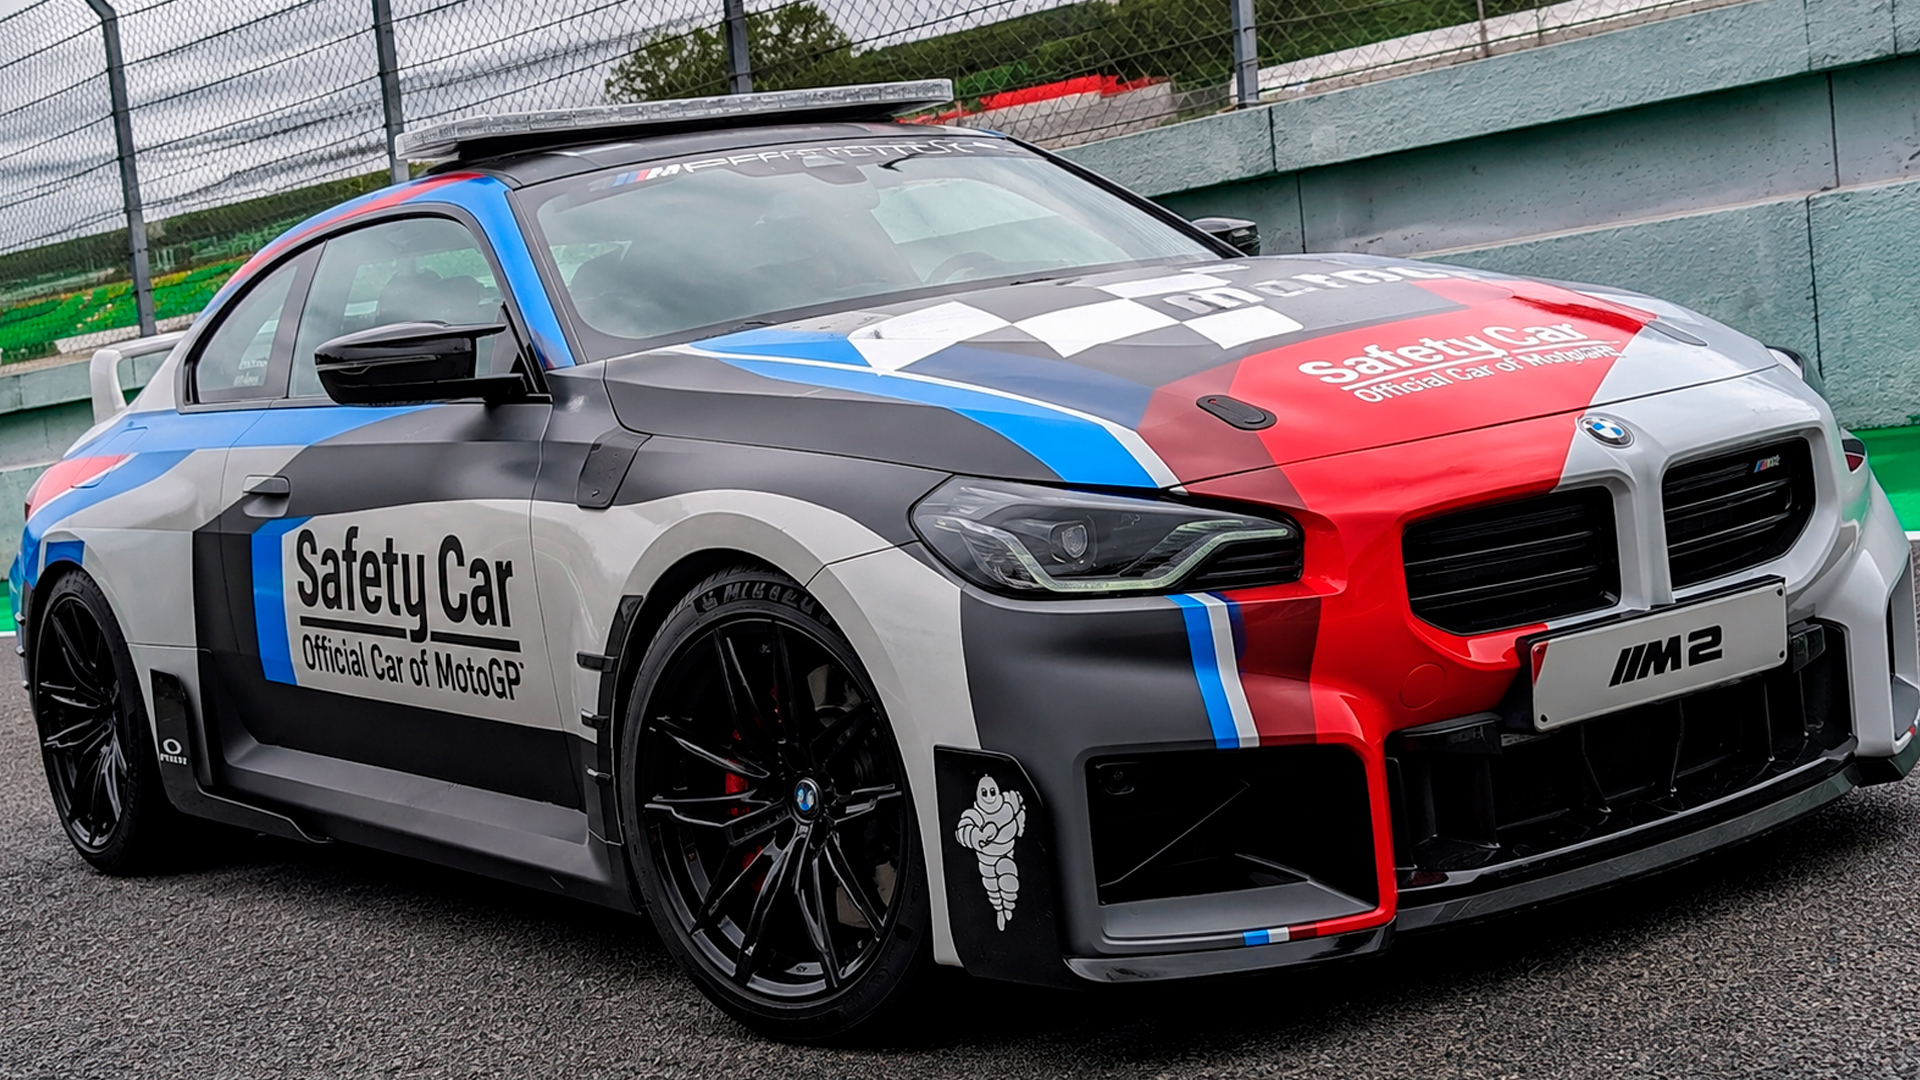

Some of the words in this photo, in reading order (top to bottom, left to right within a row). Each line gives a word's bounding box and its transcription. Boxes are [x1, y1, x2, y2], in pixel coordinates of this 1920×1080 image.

[1298, 336, 1506, 384] Safety
[1482, 323, 1588, 347] Car
[1353, 373, 1453, 403] Official
[1449, 364, 1495, 382] Car
[1495, 355, 1524, 372] of
[296, 526, 428, 643] Safety
[438, 534, 513, 628] Car
[302, 634, 369, 678] Official
[371, 643, 404, 684] Car
[409, 649, 430, 688] of
[434, 651, 522, 701] MotoGP
